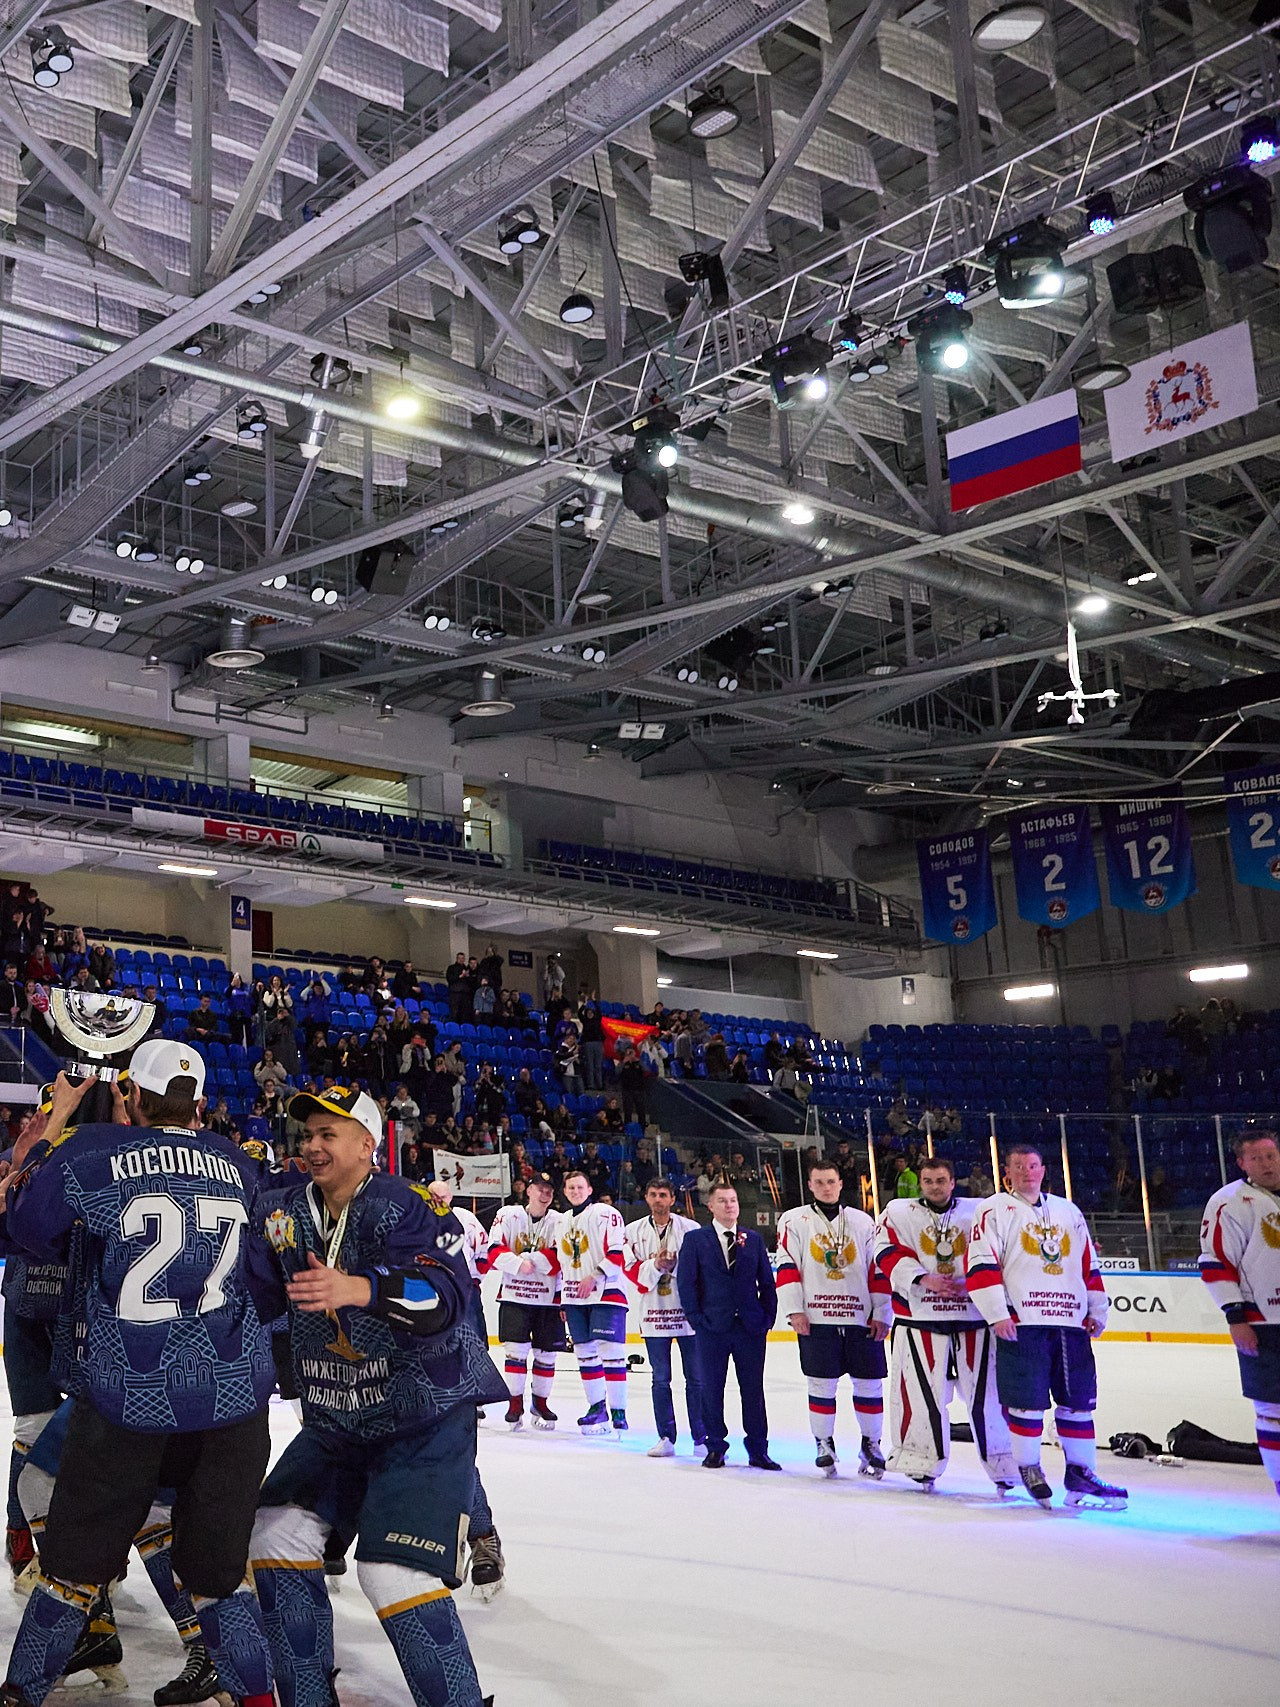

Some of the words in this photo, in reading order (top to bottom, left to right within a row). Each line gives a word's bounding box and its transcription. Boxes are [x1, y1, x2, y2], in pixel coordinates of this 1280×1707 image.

[1234, 774, 1280, 792] КОВАЛЕ
[1021, 813, 1076, 834] АСТАФЬЕВ
[1249, 812, 1280, 849] 2
[226, 827, 296, 848] SPAR
[929, 836, 975, 856] СОЛОДОВ
[1124, 835, 1174, 879] 12
[1042, 853, 1066, 892] 2
[946, 874, 968, 911] 5
[236, 900, 246, 917] 4
[905, 980, 912, 994] 5
[110, 1146, 244, 1189] КОСОЛАПОВ
[116, 1192, 249, 1326] 27
[814, 1294, 860, 1303] ПРОКУРАТУРА
[932, 1304, 967, 1312] ОБЛАСТИ
[1041, 1309, 1073, 1318] ОБЛАСТИ
